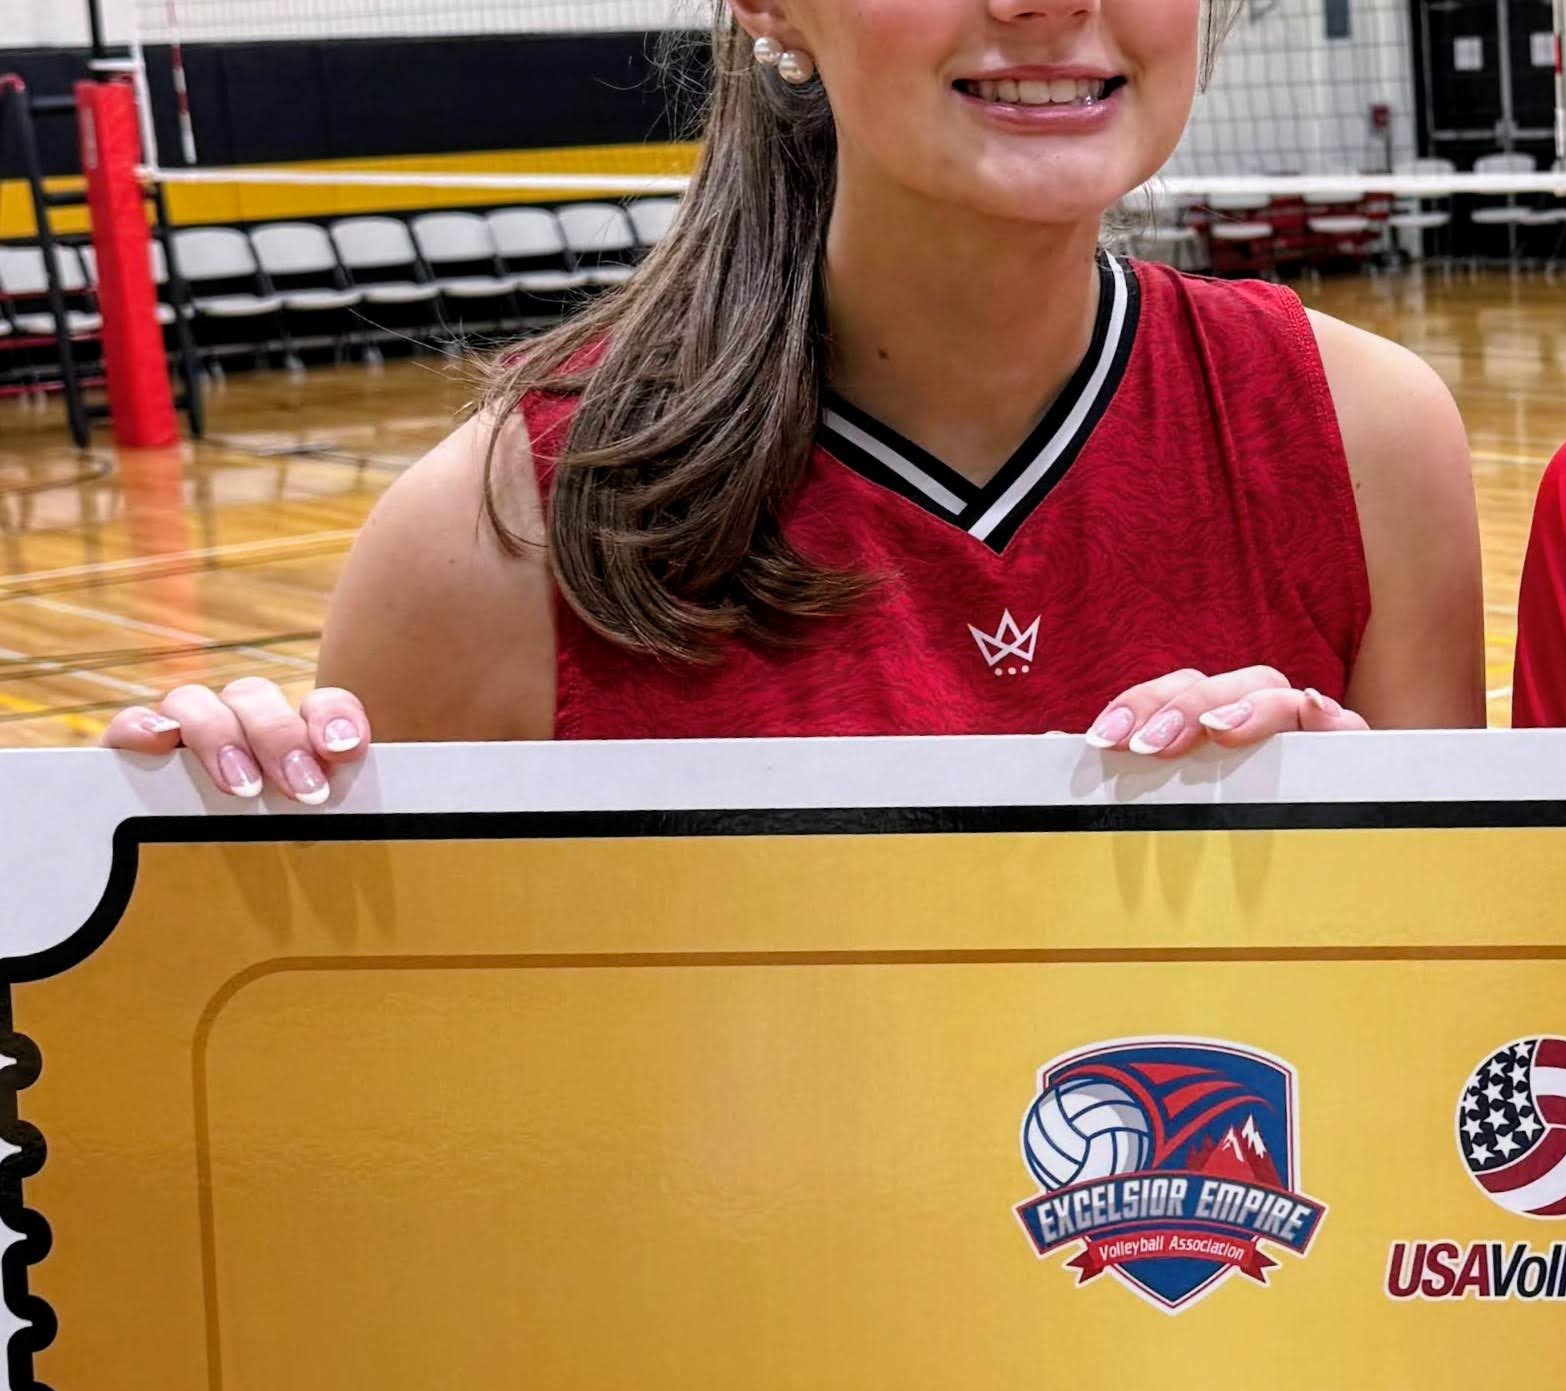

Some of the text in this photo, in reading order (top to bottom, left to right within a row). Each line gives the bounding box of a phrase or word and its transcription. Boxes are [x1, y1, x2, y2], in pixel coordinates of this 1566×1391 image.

[1035, 1177, 1312, 1244] EXCELSIOR EMPIRE
[1099, 1235, 1245, 1261] Volleyball Association
